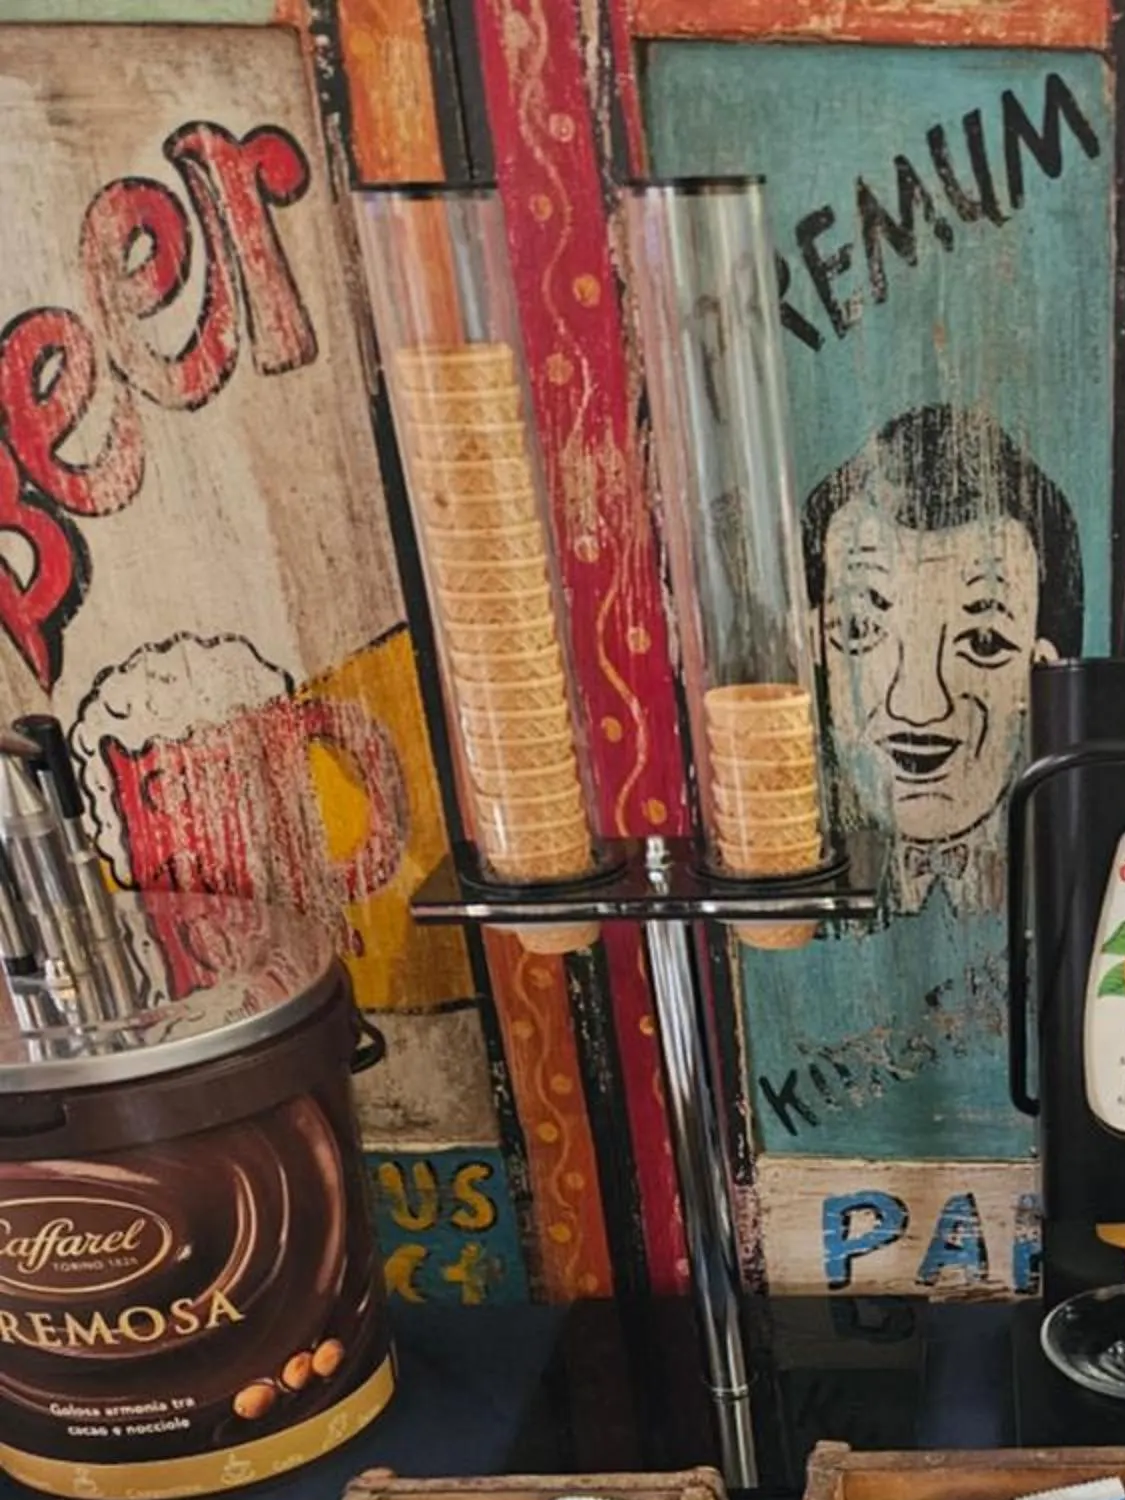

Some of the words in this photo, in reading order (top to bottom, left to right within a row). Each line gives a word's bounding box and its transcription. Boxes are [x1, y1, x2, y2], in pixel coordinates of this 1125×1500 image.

[52, 1261, 105, 1273] TORINO
[50, 1402, 101, 1417] Golosa
[104, 1398, 168, 1416] armonia
[171, 1396, 196, 1410] tra
[67, 1424, 109, 1437] cacao
